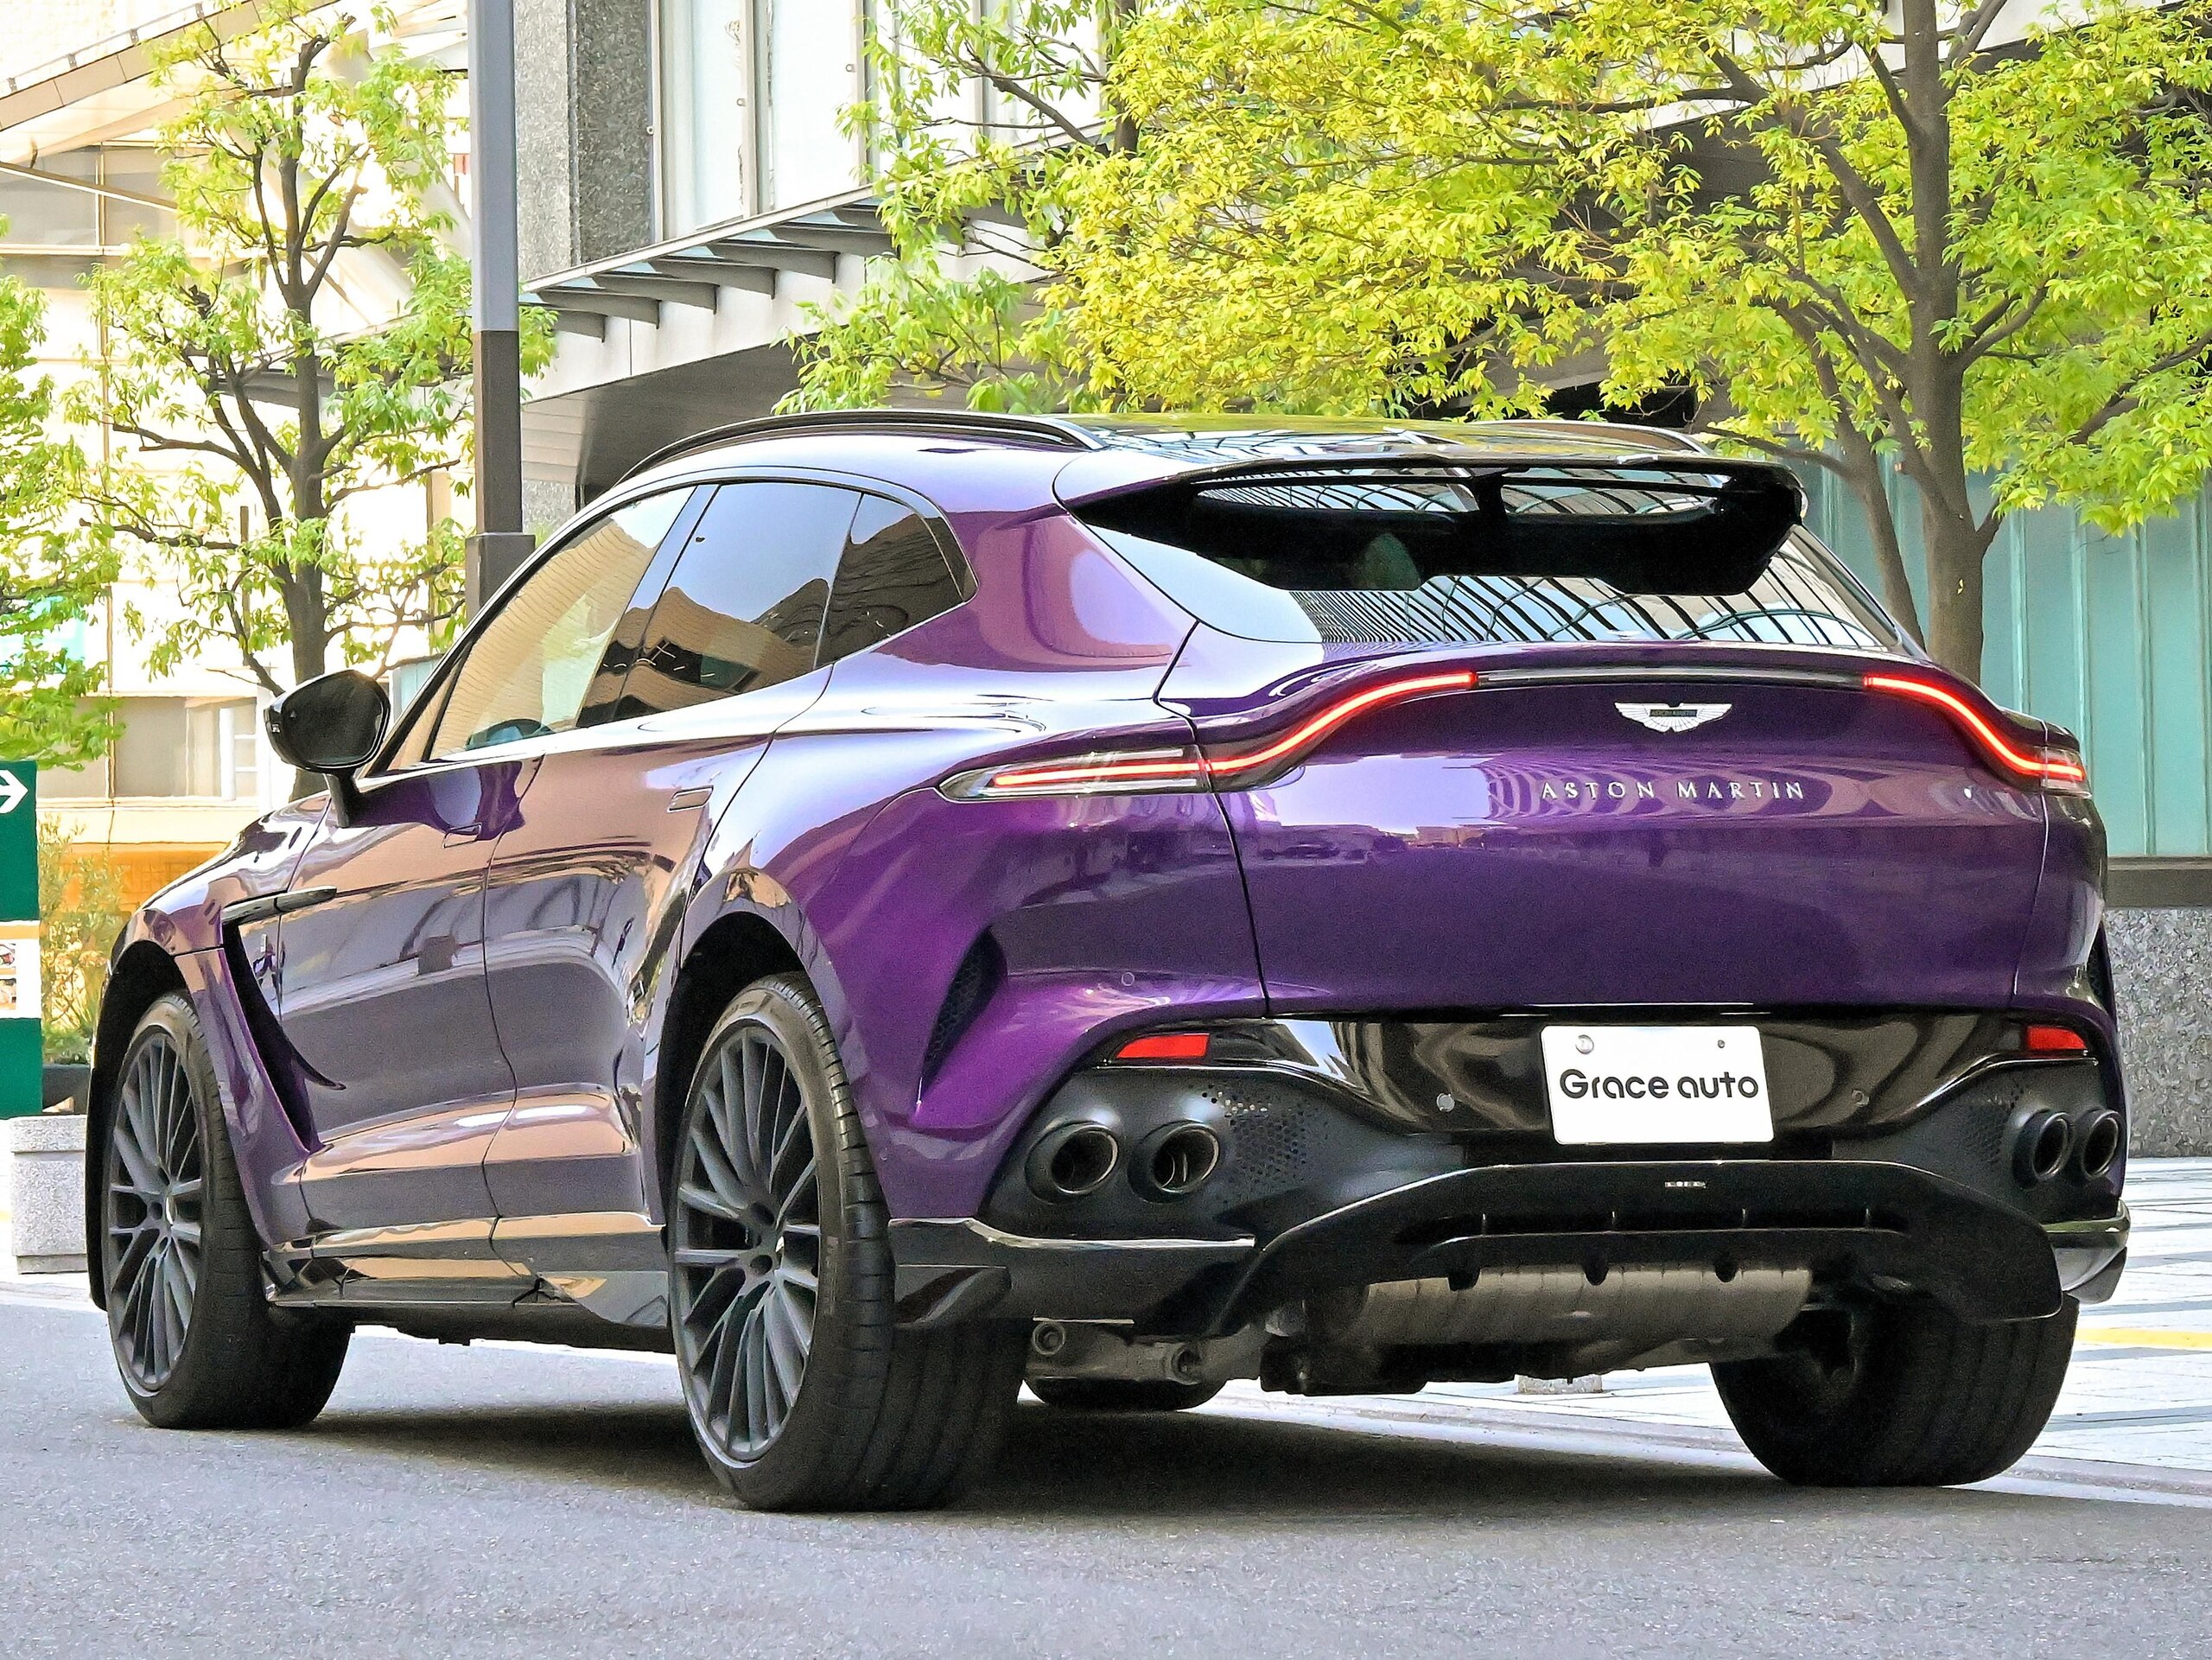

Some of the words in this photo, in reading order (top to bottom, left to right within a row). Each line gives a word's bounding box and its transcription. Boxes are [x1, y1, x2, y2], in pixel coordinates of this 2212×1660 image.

[1541, 781, 1656, 799] ASTON
[1676, 781, 1804, 799] MARTIN
[1560, 1068, 1669, 1099] Grace
[1676, 1072, 1759, 1099] auto
